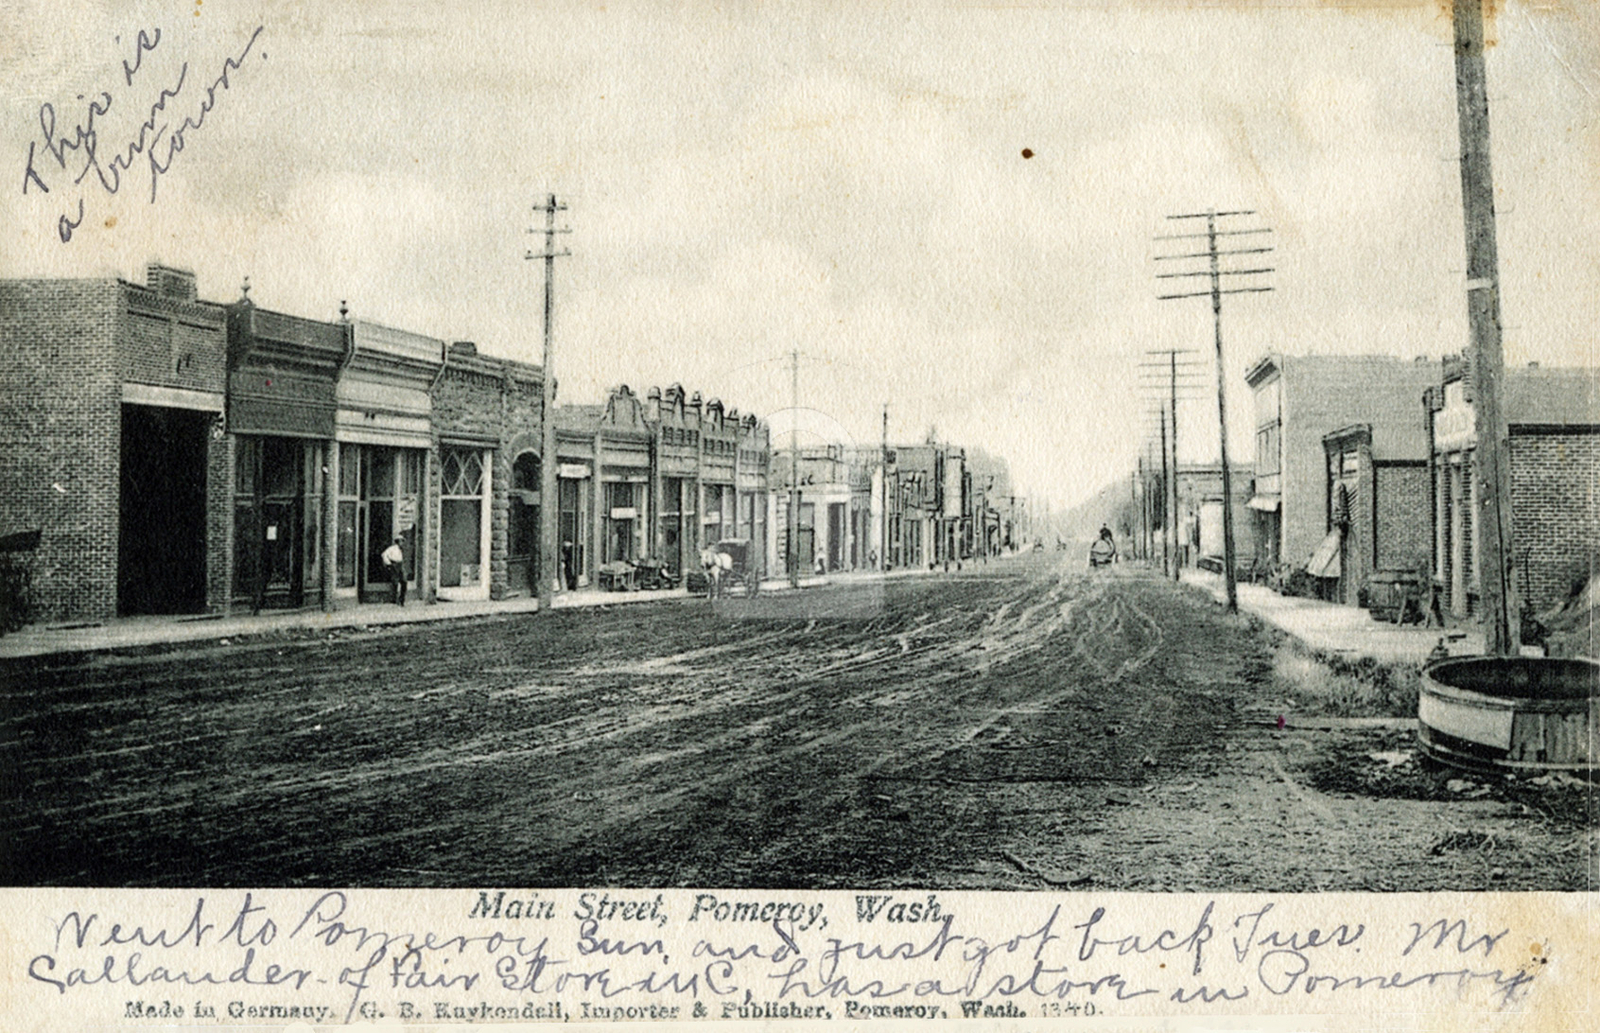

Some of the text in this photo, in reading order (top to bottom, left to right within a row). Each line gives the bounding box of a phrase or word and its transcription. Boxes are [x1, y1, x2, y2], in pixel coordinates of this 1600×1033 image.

[23, 28, 161, 194] This is
[58, 62, 187, 243] a bum
[219, 893, 277, 946] to
[289, 891, 549, 956] Pomeroy
[691, 918, 800, 962] and
[819, 914, 964, 985] just
[963, 904, 1060, 998] got
[1074, 901, 1213, 975] back
[338, 945, 388, 1024] of
[768, 958, 908, 999] has
[914, 980, 965, 997] a
[985, 960, 1160, 1000] store
[1170, 985, 1249, 1001] in
